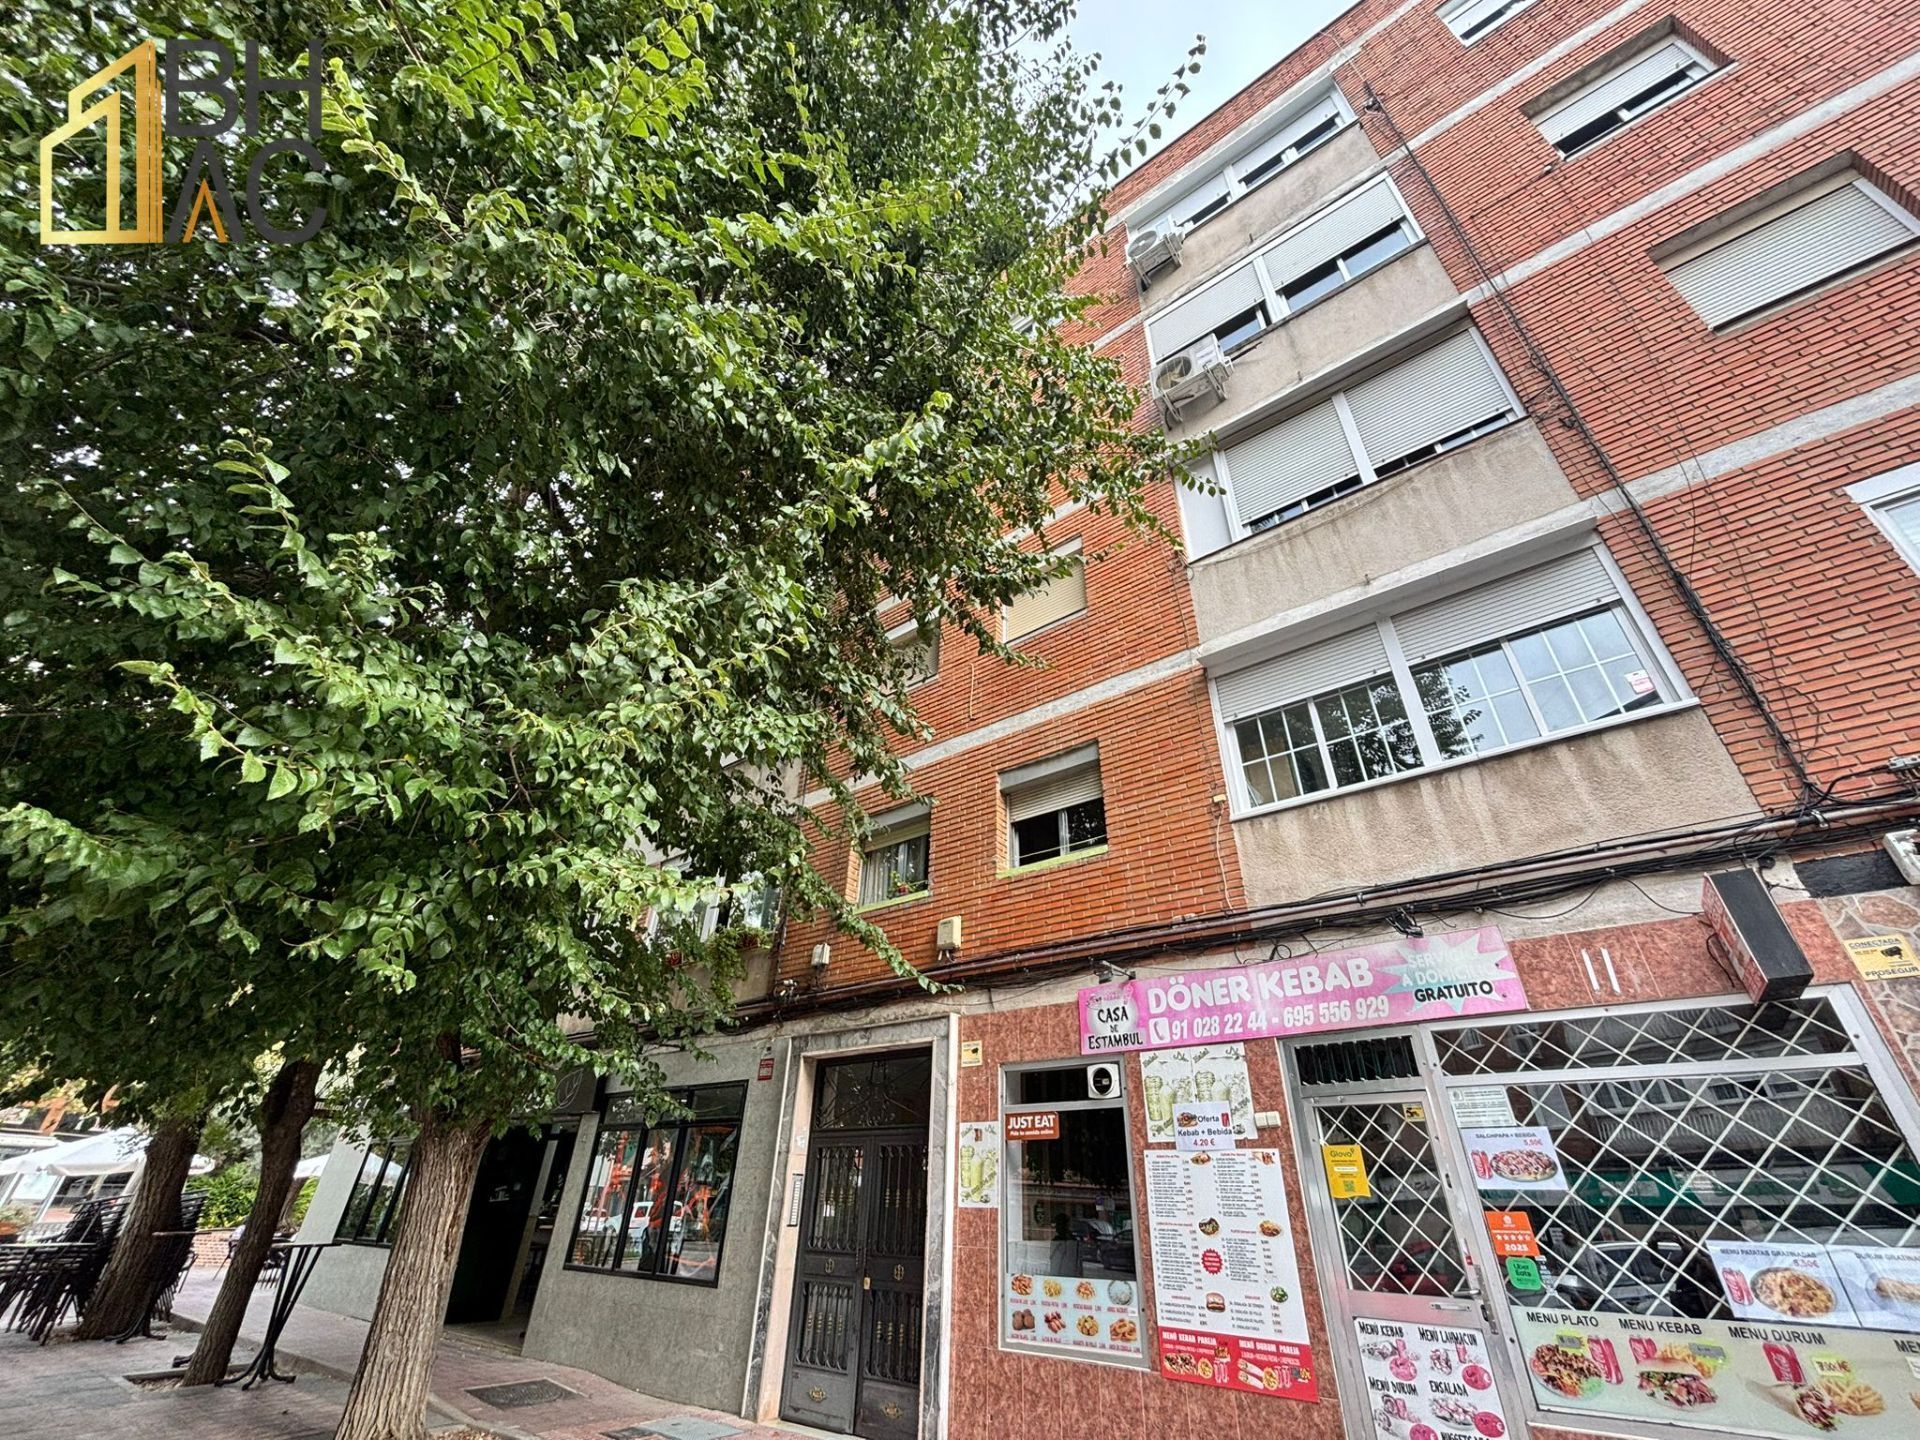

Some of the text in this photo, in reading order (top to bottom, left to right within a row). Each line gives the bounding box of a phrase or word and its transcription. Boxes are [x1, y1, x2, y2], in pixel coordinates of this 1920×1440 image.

[1848, 938, 1902, 949] CONECTADA
[1864, 966, 1920, 977] PROSEGUR
[1147, 976, 1251, 1014] DÖNER
[1257, 957, 1374, 1000] KEBAB
[1414, 980, 1494, 1003] GRATUITO
[1097, 1006, 1129, 1023] CASA
[1172, 1019, 1189, 1040] 91
[1193, 1015, 1220, 1038] 028
[1224, 1012, 1243, 1034] 22
[1247, 1010, 1268, 1031] 44
[1283, 1004, 1315, 1028] 695
[1319, 999, 1351, 1024] 556
[1355, 995, 1389, 1020] 929
[1109, 1024, 1119, 1033] DE
[1088, 1032, 1144, 1050] ESTAMBUL
[1007, 1115, 1056, 1129] JUST EAT
[1197, 1115, 1220, 1123] Oferta
[1178, 1128, 1200, 1136] Kebab
[1207, 1127, 1233, 1136] Bebida
[1526, 1311, 1599, 1328] MENU PLATO
[1618, 1318, 1702, 1335] MENU KEBAB
[1380, 1324, 1405, 1338] KEBAB
[1440, 1328, 1478, 1346] LAHMACUN
[1728, 1326, 1826, 1345] MENU DURUM
[1391, 1380, 1419, 1396] DURUM
[1429, 1380, 1469, 1397] ENSALADA
